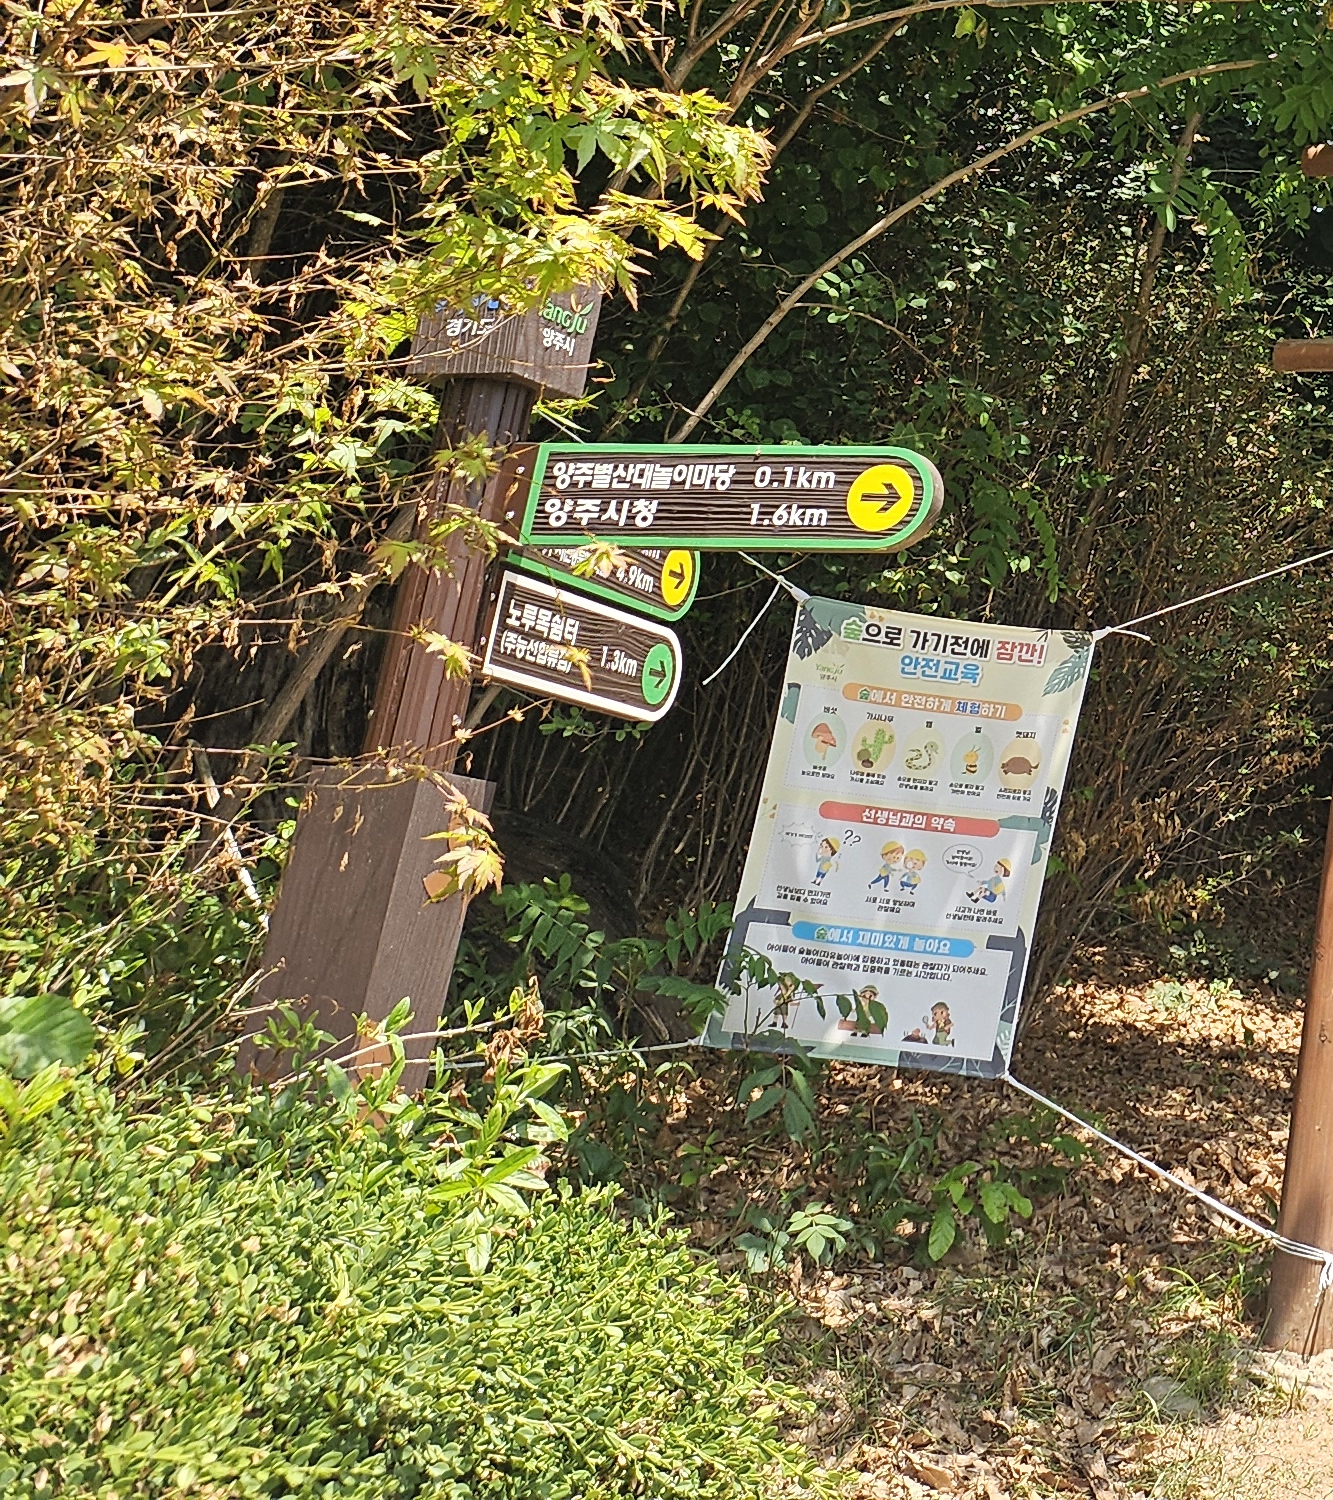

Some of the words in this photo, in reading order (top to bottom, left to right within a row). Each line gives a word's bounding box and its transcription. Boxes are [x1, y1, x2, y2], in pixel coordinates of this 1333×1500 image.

[541, 298, 588, 334] angju
[542, 327, 576, 356] 양주시
[552, 461, 737, 490] 양주별산대놀이마당
[754, 465, 836, 488] 0.1km
[545, 499, 659, 527] 양주시청
[749, 503, 829, 527] 1.6km
[505, 598, 580, 646] 노루목쉼터
[843, 618, 902, 647] 숲으로
[910, 629, 991, 658] 가기전에
[996, 640, 1045, 665] 잠깐!
[601, 645, 638, 677] 1.3km
[901, 654, 981, 684] 안전교육
[858, 688, 896, 705] 숲에서
[901, 693, 951, 712] 안전하게
[955, 700, 1006, 718] 체험하기
[866, 712, 894, 723] 가시나무
[862, 808, 927, 829] 선생님과의
[931, 816, 956, 832] 약속
[815, 926, 853, 943] 숲에서
[857, 931, 909, 950] 재미있게
[913, 937, 951, 954] 놀아요
